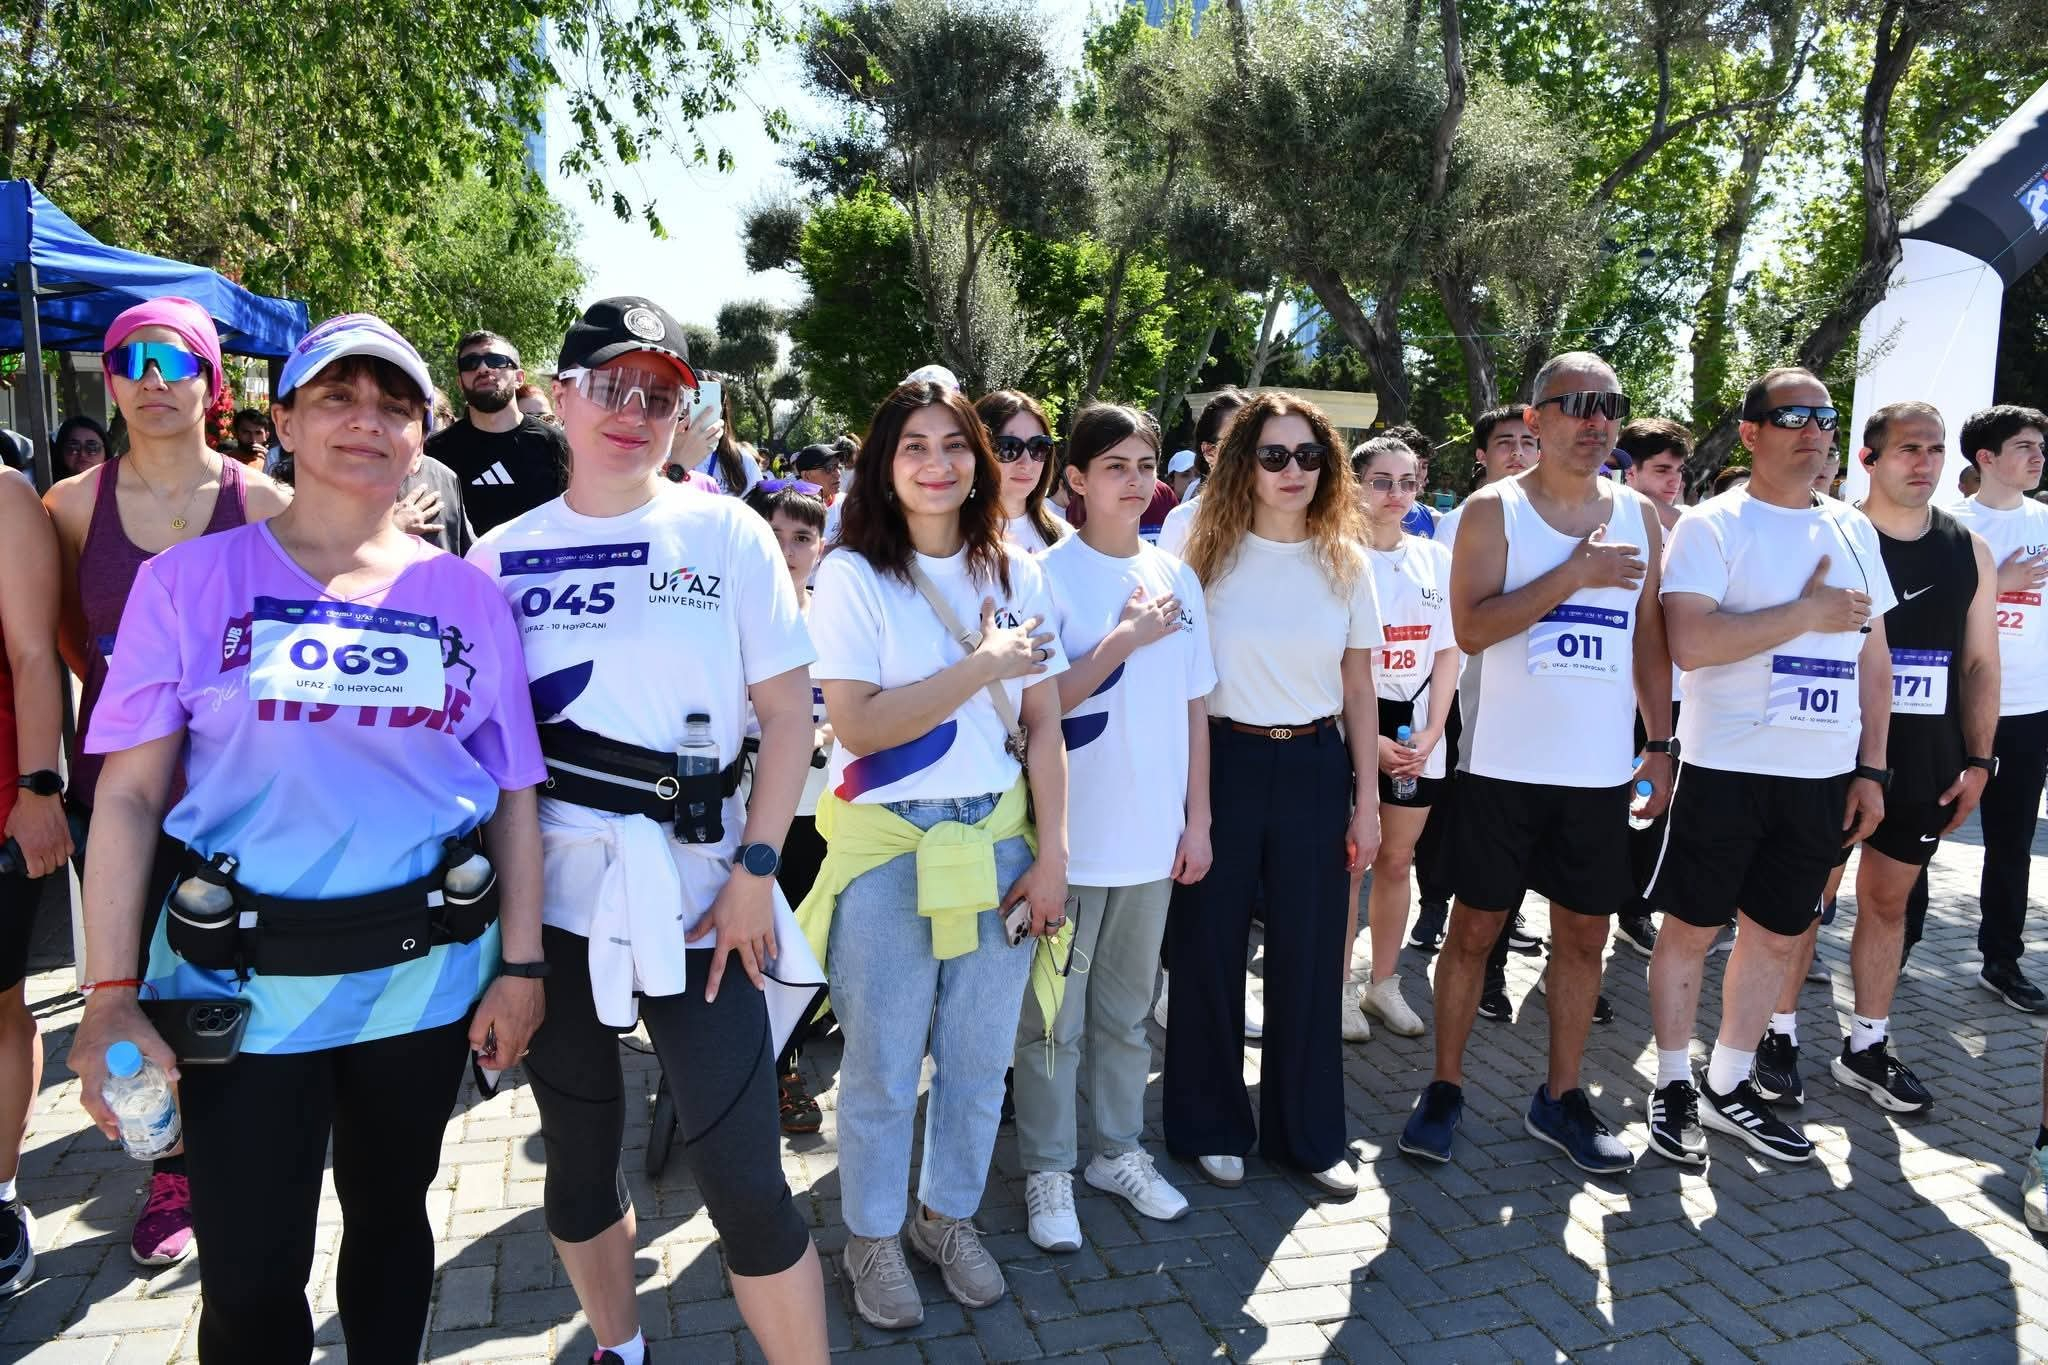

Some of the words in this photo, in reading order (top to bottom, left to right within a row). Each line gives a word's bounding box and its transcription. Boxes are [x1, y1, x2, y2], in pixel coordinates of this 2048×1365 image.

[649, 566, 721, 599] UFAZ
[521, 581, 615, 618] 045
[649, 594, 720, 612] UNIVERSITY
[524, 623, 544, 634] UFAZ
[551, 623, 561, 631] 10
[562, 621, 607, 631] HƏYƏCANI
[223, 626, 243, 660] CLUB
[289, 638, 409, 676] 069
[1557, 633, 1602, 661] 011
[1382, 649, 1416, 670] 128
[296, 680, 325, 690] UFAZ
[334, 683, 345, 692] 10
[347, 684, 403, 694] HƏYƏCANI
[1797, 686, 1839, 714] 101
[1892, 675, 1932, 698] 171
